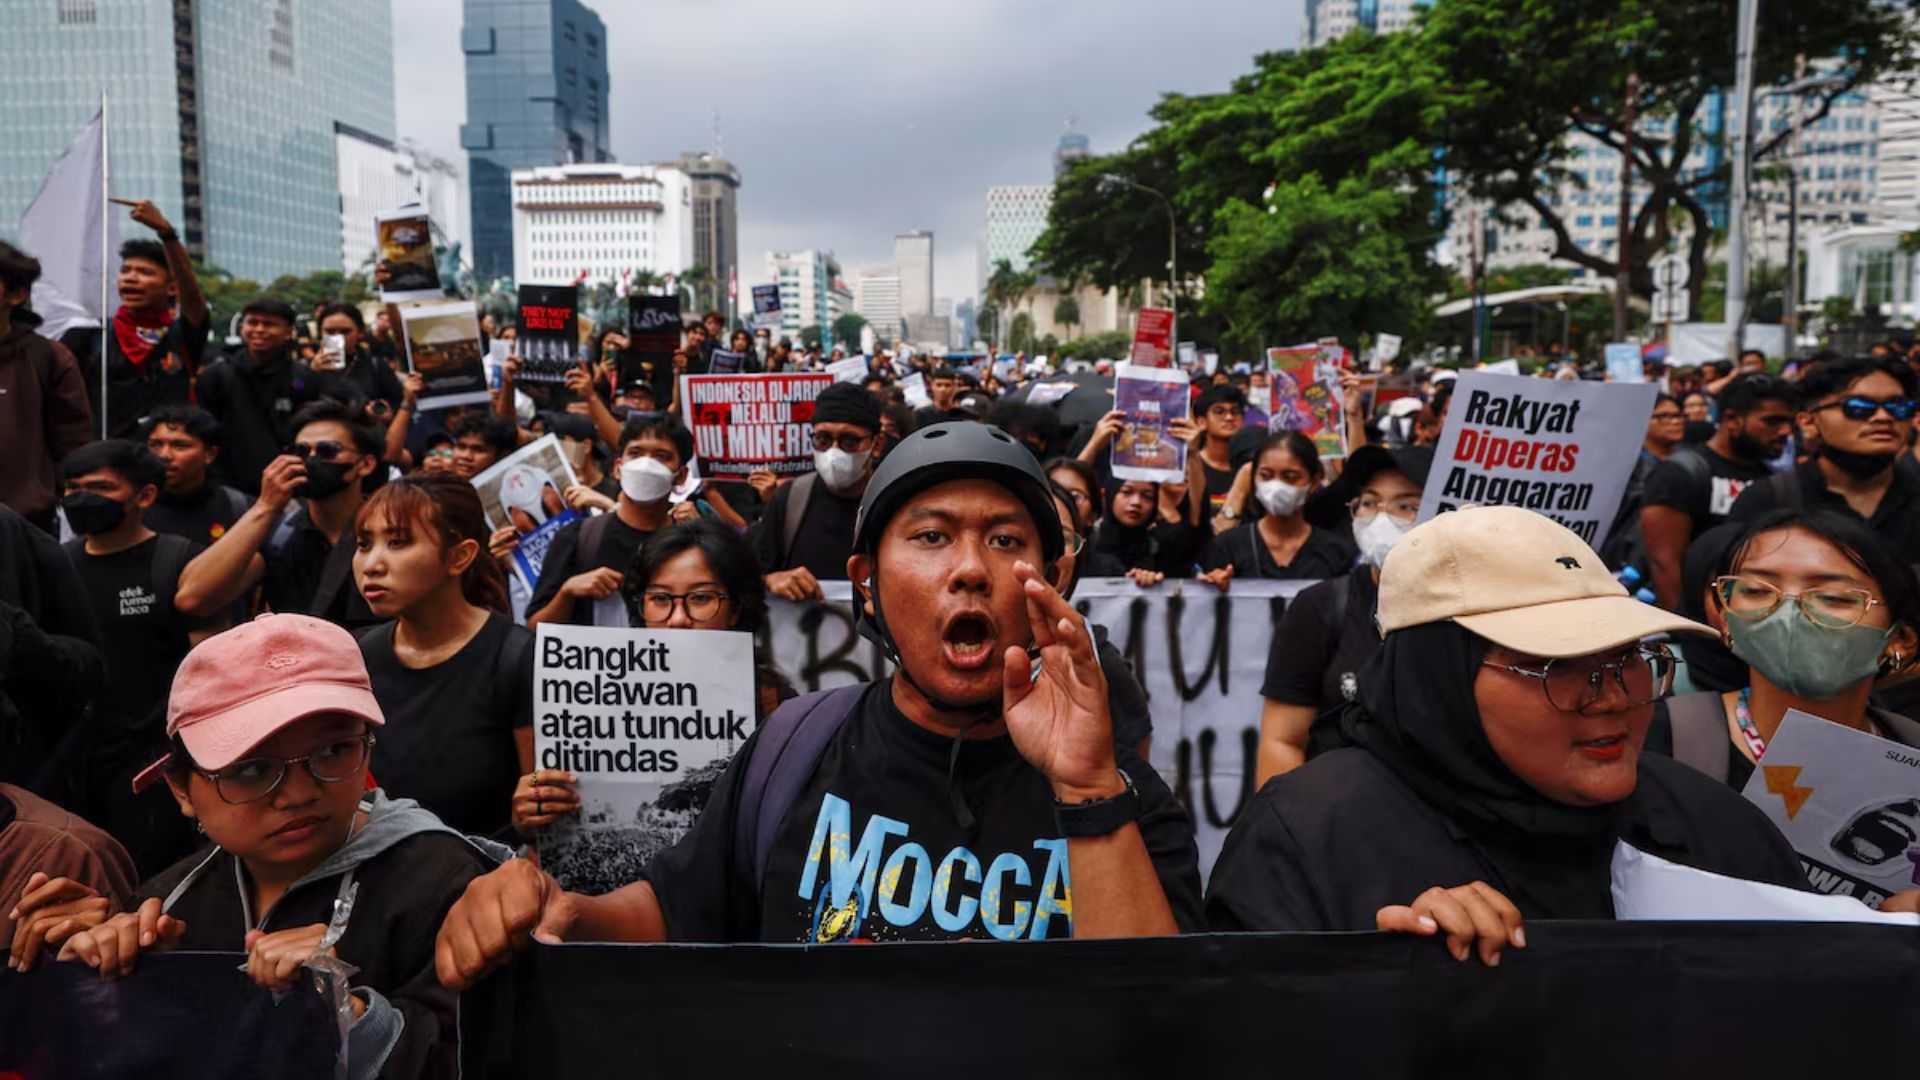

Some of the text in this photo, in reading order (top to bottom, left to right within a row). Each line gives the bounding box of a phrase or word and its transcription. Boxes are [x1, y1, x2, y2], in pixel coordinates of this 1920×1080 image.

[692, 381, 766, 403] INDONESIA
[731, 403, 791, 424] MELALUI
[1464, 389, 1581, 435] Rakyat
[696, 423, 814, 459] UU MINERB
[1454, 429, 1580, 473] Diperas
[1442, 467, 1594, 512] Anggaran
[542, 636, 670, 680] Bangkit
[541, 674, 698, 706] melawan
[541, 708, 748, 741] atau tunduk
[541, 740, 679, 773] ditindas
[798, 792, 1073, 942] MOCCA
